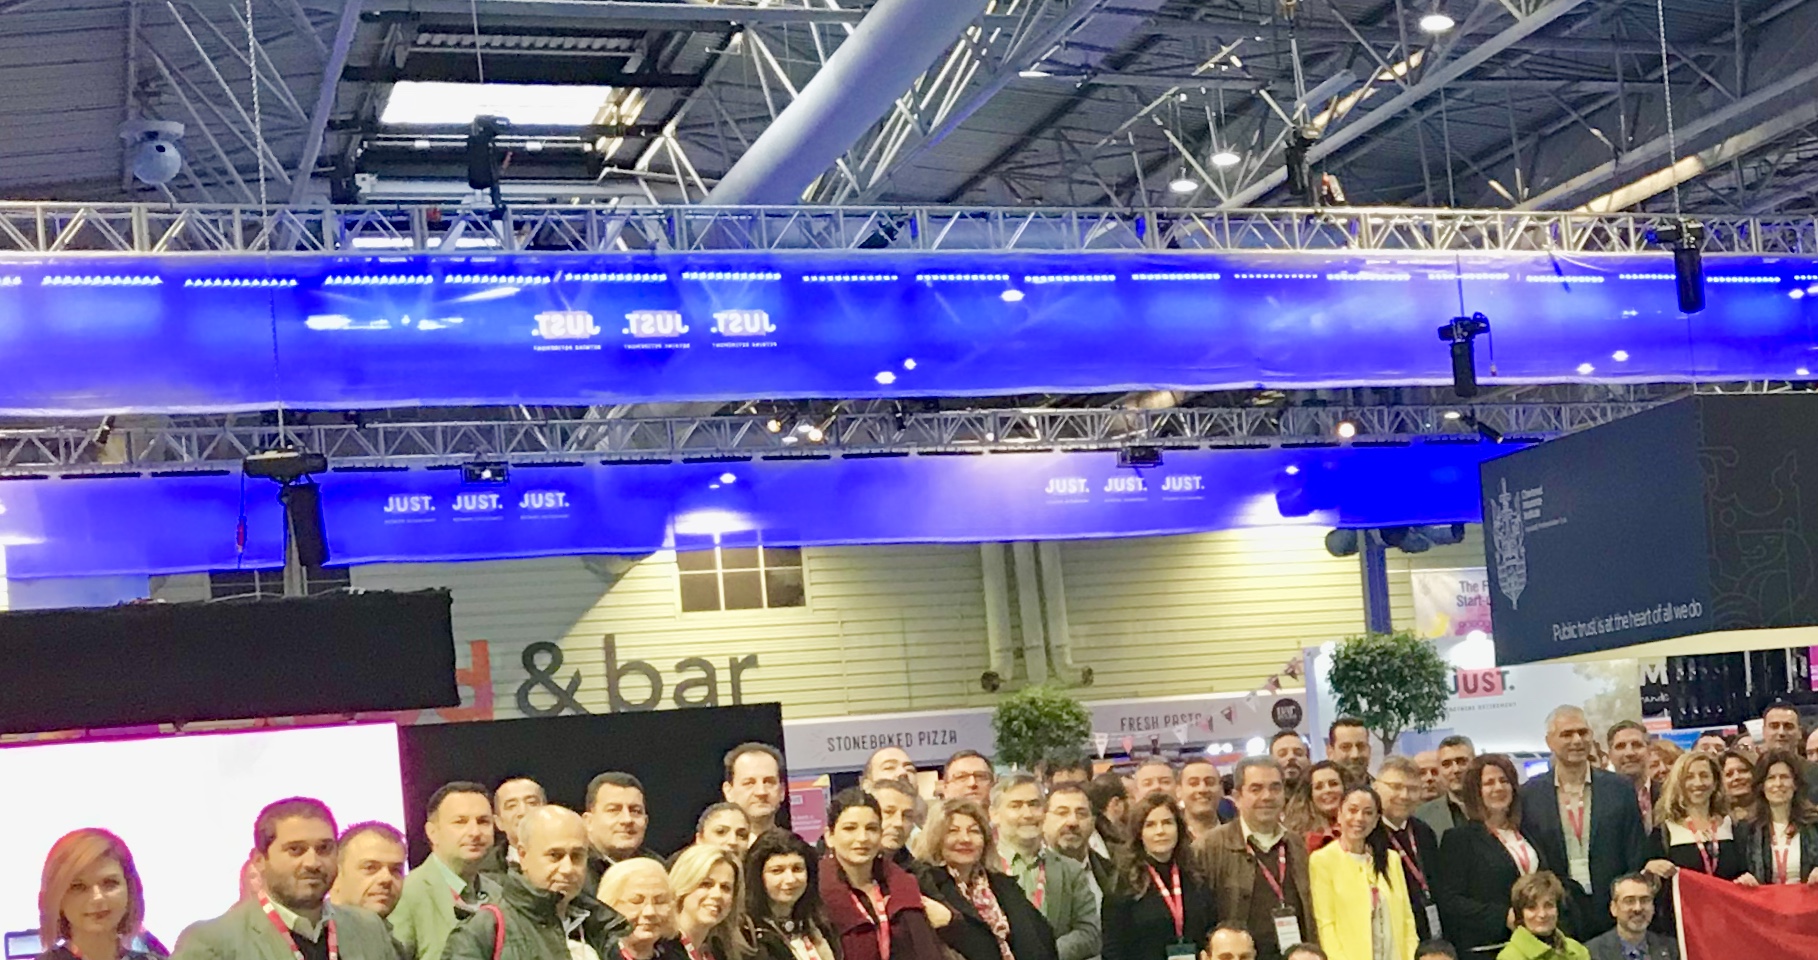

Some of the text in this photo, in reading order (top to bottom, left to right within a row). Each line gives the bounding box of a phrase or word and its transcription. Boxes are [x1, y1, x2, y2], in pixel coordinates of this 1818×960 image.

[1045, 478, 1090, 494] JUST.
[1104, 477, 1148, 492] JUST.
[1161, 476, 1205, 491] JUST.
[384, 495, 436, 512] JUST.
[452, 494, 503, 511] JUST.
[519, 492, 570, 509] JUST.
[1459, 580, 1479, 593] The
[1552, 619, 1577, 641] Public
[1577, 618, 1597, 638] trust
[1629, 609, 1652, 628] heart
[1674, 605, 1689, 620] we
[1688, 599, 1702, 618] do
[515, 641, 593, 718] &
[603, 633, 760, 713] bar
[1445, 669, 1515, 696] JUST.
[1120, 715, 1159, 732] FRESH
[827, 729, 958, 752] STONEBAKED PIZZA
